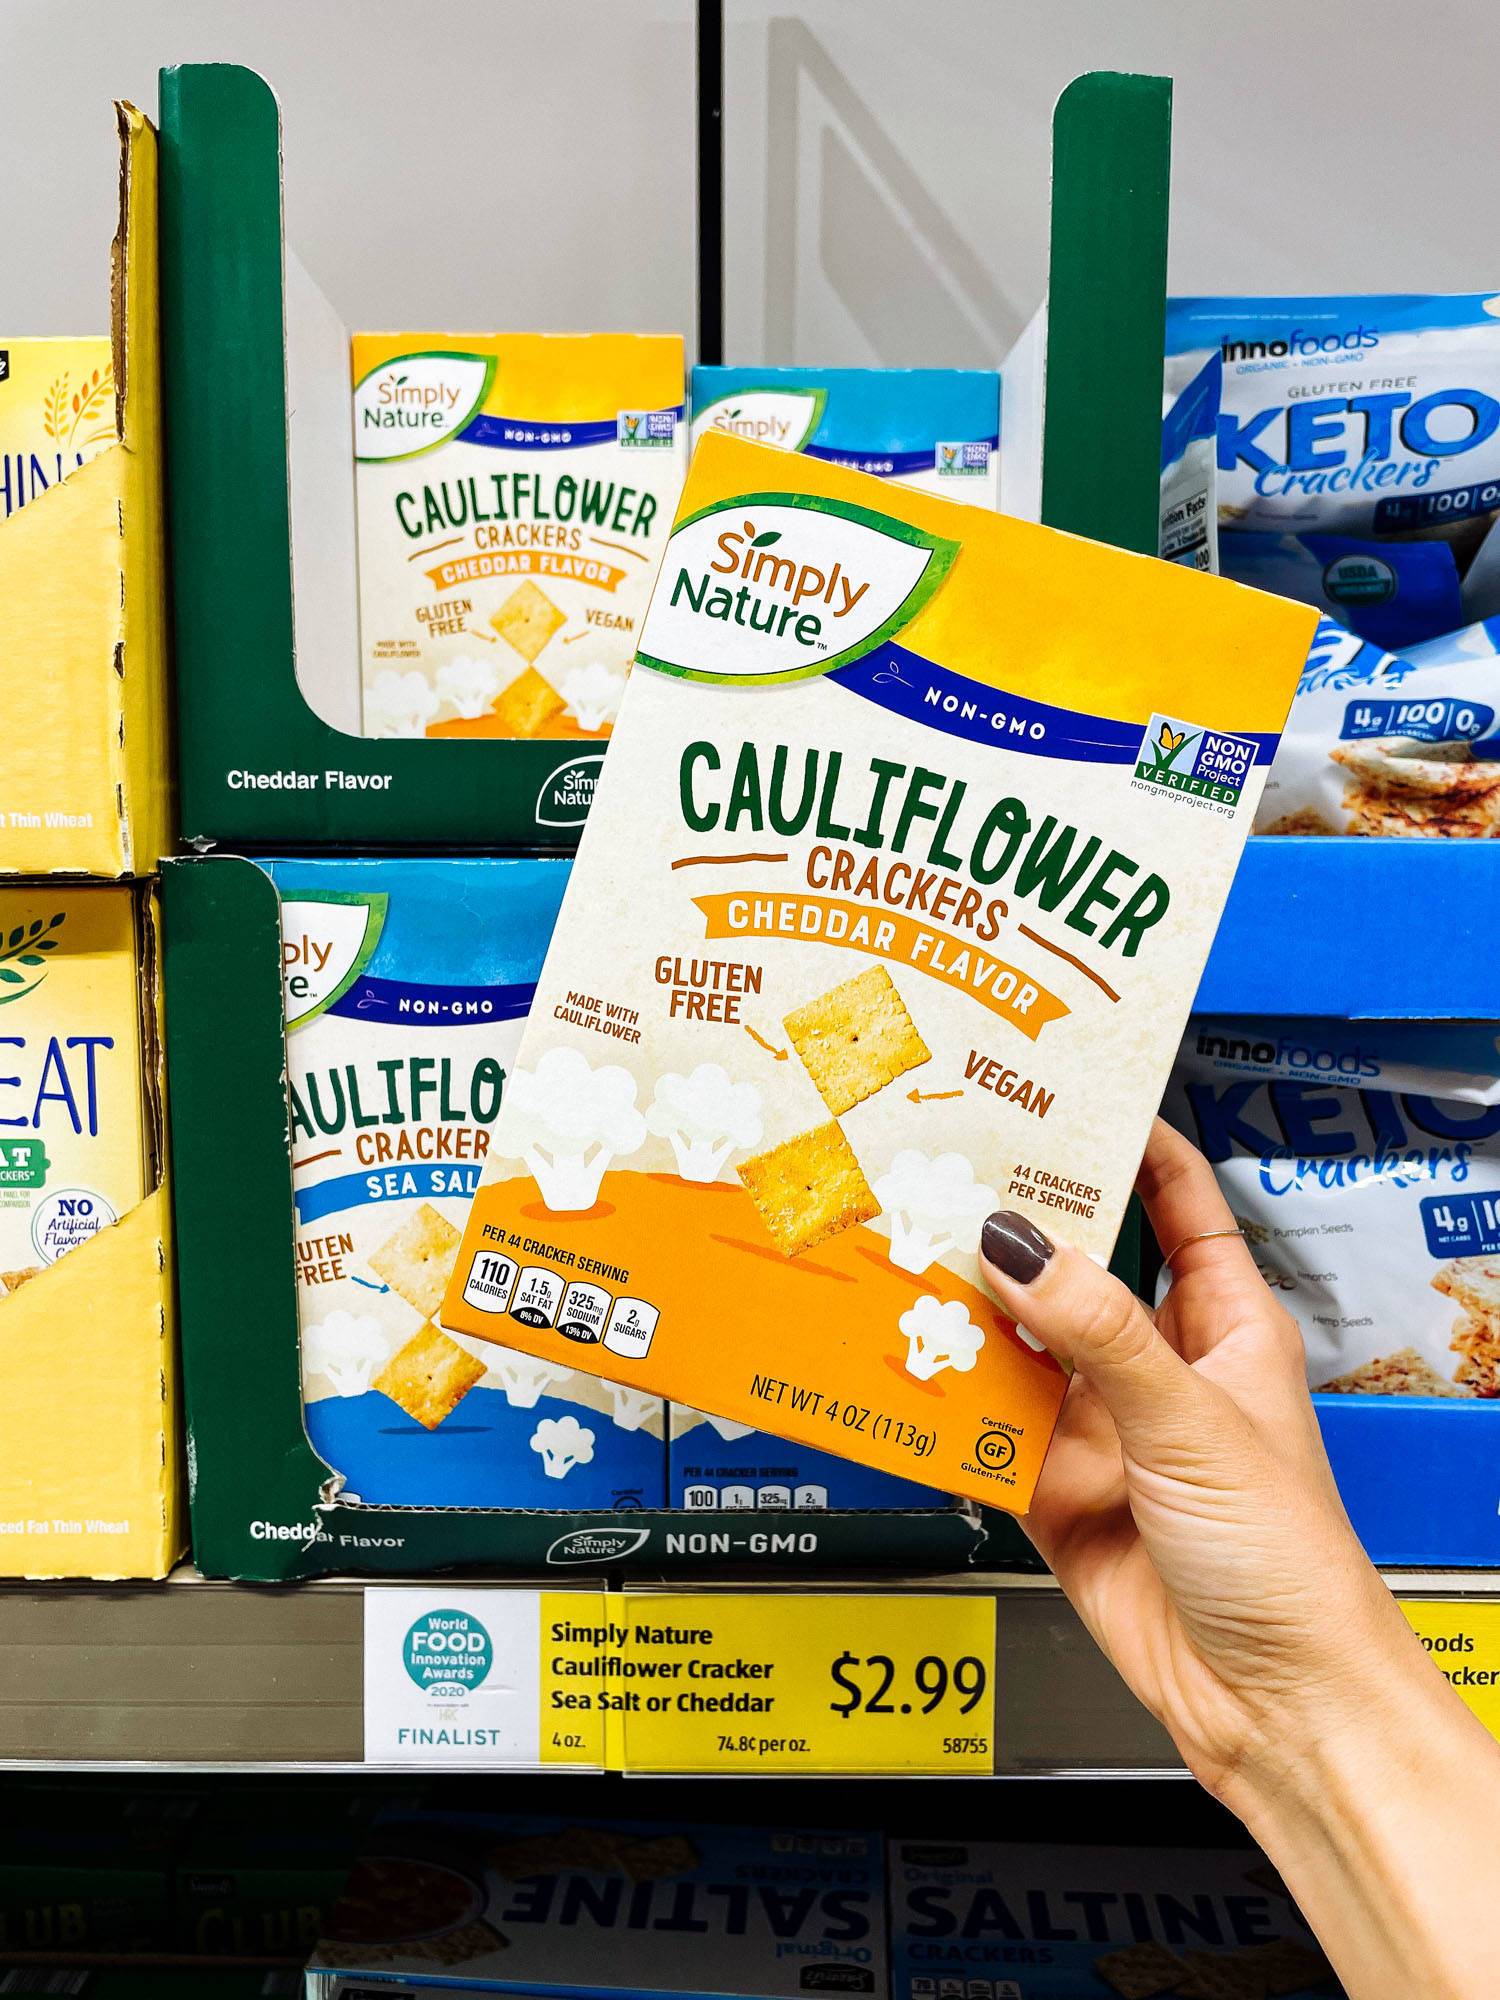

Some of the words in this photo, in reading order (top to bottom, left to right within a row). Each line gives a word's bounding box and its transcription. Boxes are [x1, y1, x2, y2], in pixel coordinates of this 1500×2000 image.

[1221, 324, 1379, 364] innofoods
[378, 380, 461, 409] Simply
[1287, 380, 1363, 399] GLUTEN
[1369, 375, 1418, 390] FREE
[364, 408, 442, 428] Nature
[1216, 389, 1500, 473] KETO
[1254, 447, 1441, 498] Crackers
[395, 472, 658, 539] CAULIFLOWER
[475, 523, 582, 551] CRACKERS
[441, 555, 531, 584] CHEDDAR
[539, 554, 613, 584] FLAVOR
[710, 530, 870, 617] Simply
[415, 599, 472, 625] GLUTEN
[670, 568, 822, 647] Nature
[429, 616, 467, 639] FREE
[585, 609, 635, 632] VEGAN
[924, 686, 1046, 741] NON-GMO
[1397, 701, 1445, 725] 100
[1205, 736, 1250, 761] NON
[1200, 751, 1246, 775] GMO
[227, 770, 319, 789] Cheddar
[325, 770, 393, 789] Flavor
[1141, 765, 1237, 804] VERIFIED
[1196, 764, 1241, 787] Project
[1130, 778, 1236, 819] nongmoproject.org
[9, 812, 42, 828] Thin
[45, 812, 94, 828] Wheat
[679, 740, 1171, 958] CAULIFLOWER
[806, 846, 1009, 942] CRACKERS
[727, 898, 897, 952] CHEDDAR
[911, 931, 1039, 1016] FLAVOR
[655, 956, 763, 994] GLUTEN
[399, 998, 494, 1015] NON-GMO
[566, 990, 604, 1015] MADE
[605, 1002, 640, 1026] WITH
[670, 989, 741, 1025] FREE
[553, 1005, 642, 1045] CAULIFLOWER
[1196, 1026, 1381, 1078] innofoods
[964, 1049, 1056, 1119] VEGAN
[1258, 1131, 1473, 1197] Crackers
[366, 1172, 418, 1198] SEA
[1013, 1164, 1030, 1179] 44
[1033, 1170, 1102, 1202] CRACKERS
[58, 1199, 94, 1216] NO
[1007, 1180, 1036, 1200] PER
[1037, 1190, 1096, 1219] SERVING
[48, 1217, 100, 1234] Artificial
[1273, 1225, 1319, 1239] Pumpkin
[1320, 1222, 1354, 1235] Seeds
[1433, 1205, 1469, 1232] 4g
[296, 1232, 354, 1265] UTEN
[482, 1223, 505, 1243] PER
[507, 1233, 521, 1249] 44
[522, 1238, 576, 1267] CRACKER
[577, 1256, 630, 1284] SERVING
[480, 1258, 510, 1286] 110
[469, 1279, 508, 1300] CALORIES
[530, 1277, 552, 1298] 1.5g
[519, 1291, 536, 1306] SAT
[537, 1296, 555, 1311] FAT
[569, 1290, 604, 1317] 325mg
[533, 1314, 545, 1325] DV
[566, 1307, 600, 1327] SODIUM
[626, 1309, 640, 1328] 2g
[1341, 1315, 1374, 1328] Seeds
[581, 1329, 593, 1341] DV
[613, 1322, 648, 1342] SUGARS
[750, 1374, 789, 1404] NET
[791, 1385, 824, 1416] WT
[825, 1400, 838, 1422] 4
[842, 1404, 875, 1433] OZ
[871, 1413, 938, 1458] (113g)
[981, 1416, 1025, 1437] Certified
[983, 1441, 1008, 1459] GF
[961, 1461, 1017, 1487] Gluten-Free
[688, 1489, 714, 1507] 100
[27, 1519, 49, 1534] Fat
[52, 1519, 82, 1534] Thin
[85, 1519, 129, 1534] Wheat
[250, 1520, 334, 1543] Cheddar
[340, 1535, 405, 1547] Flavor
[564, 1545, 616, 1555] Nature
[572, 1536, 626, 1549] Simply
[666, 1533, 818, 1554] NON-GMO
[428, 1616, 468, 1631] World
[551, 1622, 628, 1648] Simply
[635, 1626, 713, 1646] Nature
[411, 1632, 485, 1653] FOOD
[1415, 1632, 1474, 1653] oods
[411, 1653, 486, 1667] Innovation
[551, 1656, 682, 1679] Cauliflower
[687, 1659, 774, 1680] Cracker
[422, 1667, 475, 1680] Awards
[829, 1651, 987, 1719] $2.99
[431, 1686, 465, 1697] 2020
[551, 1691, 591, 1711] Sea
[598, 1692, 640, 1712] Salt
[647, 1697, 671, 1713] or
[676, 1692, 775, 1713] Cheddar
[398, 1728, 502, 1746] FINALIST
[552, 1731, 562, 1748] 4
[564, 1735, 586, 1748] oz.
[717, 1735, 757, 1753] 74.8¢
[759, 1738, 779, 1756] per
[780, 1738, 811, 1753] oz.
[942, 1737, 988, 1754] 58755
[502, 1873, 871, 1941] SALTINE
[906, 1885, 1281, 1946] SALTINE
